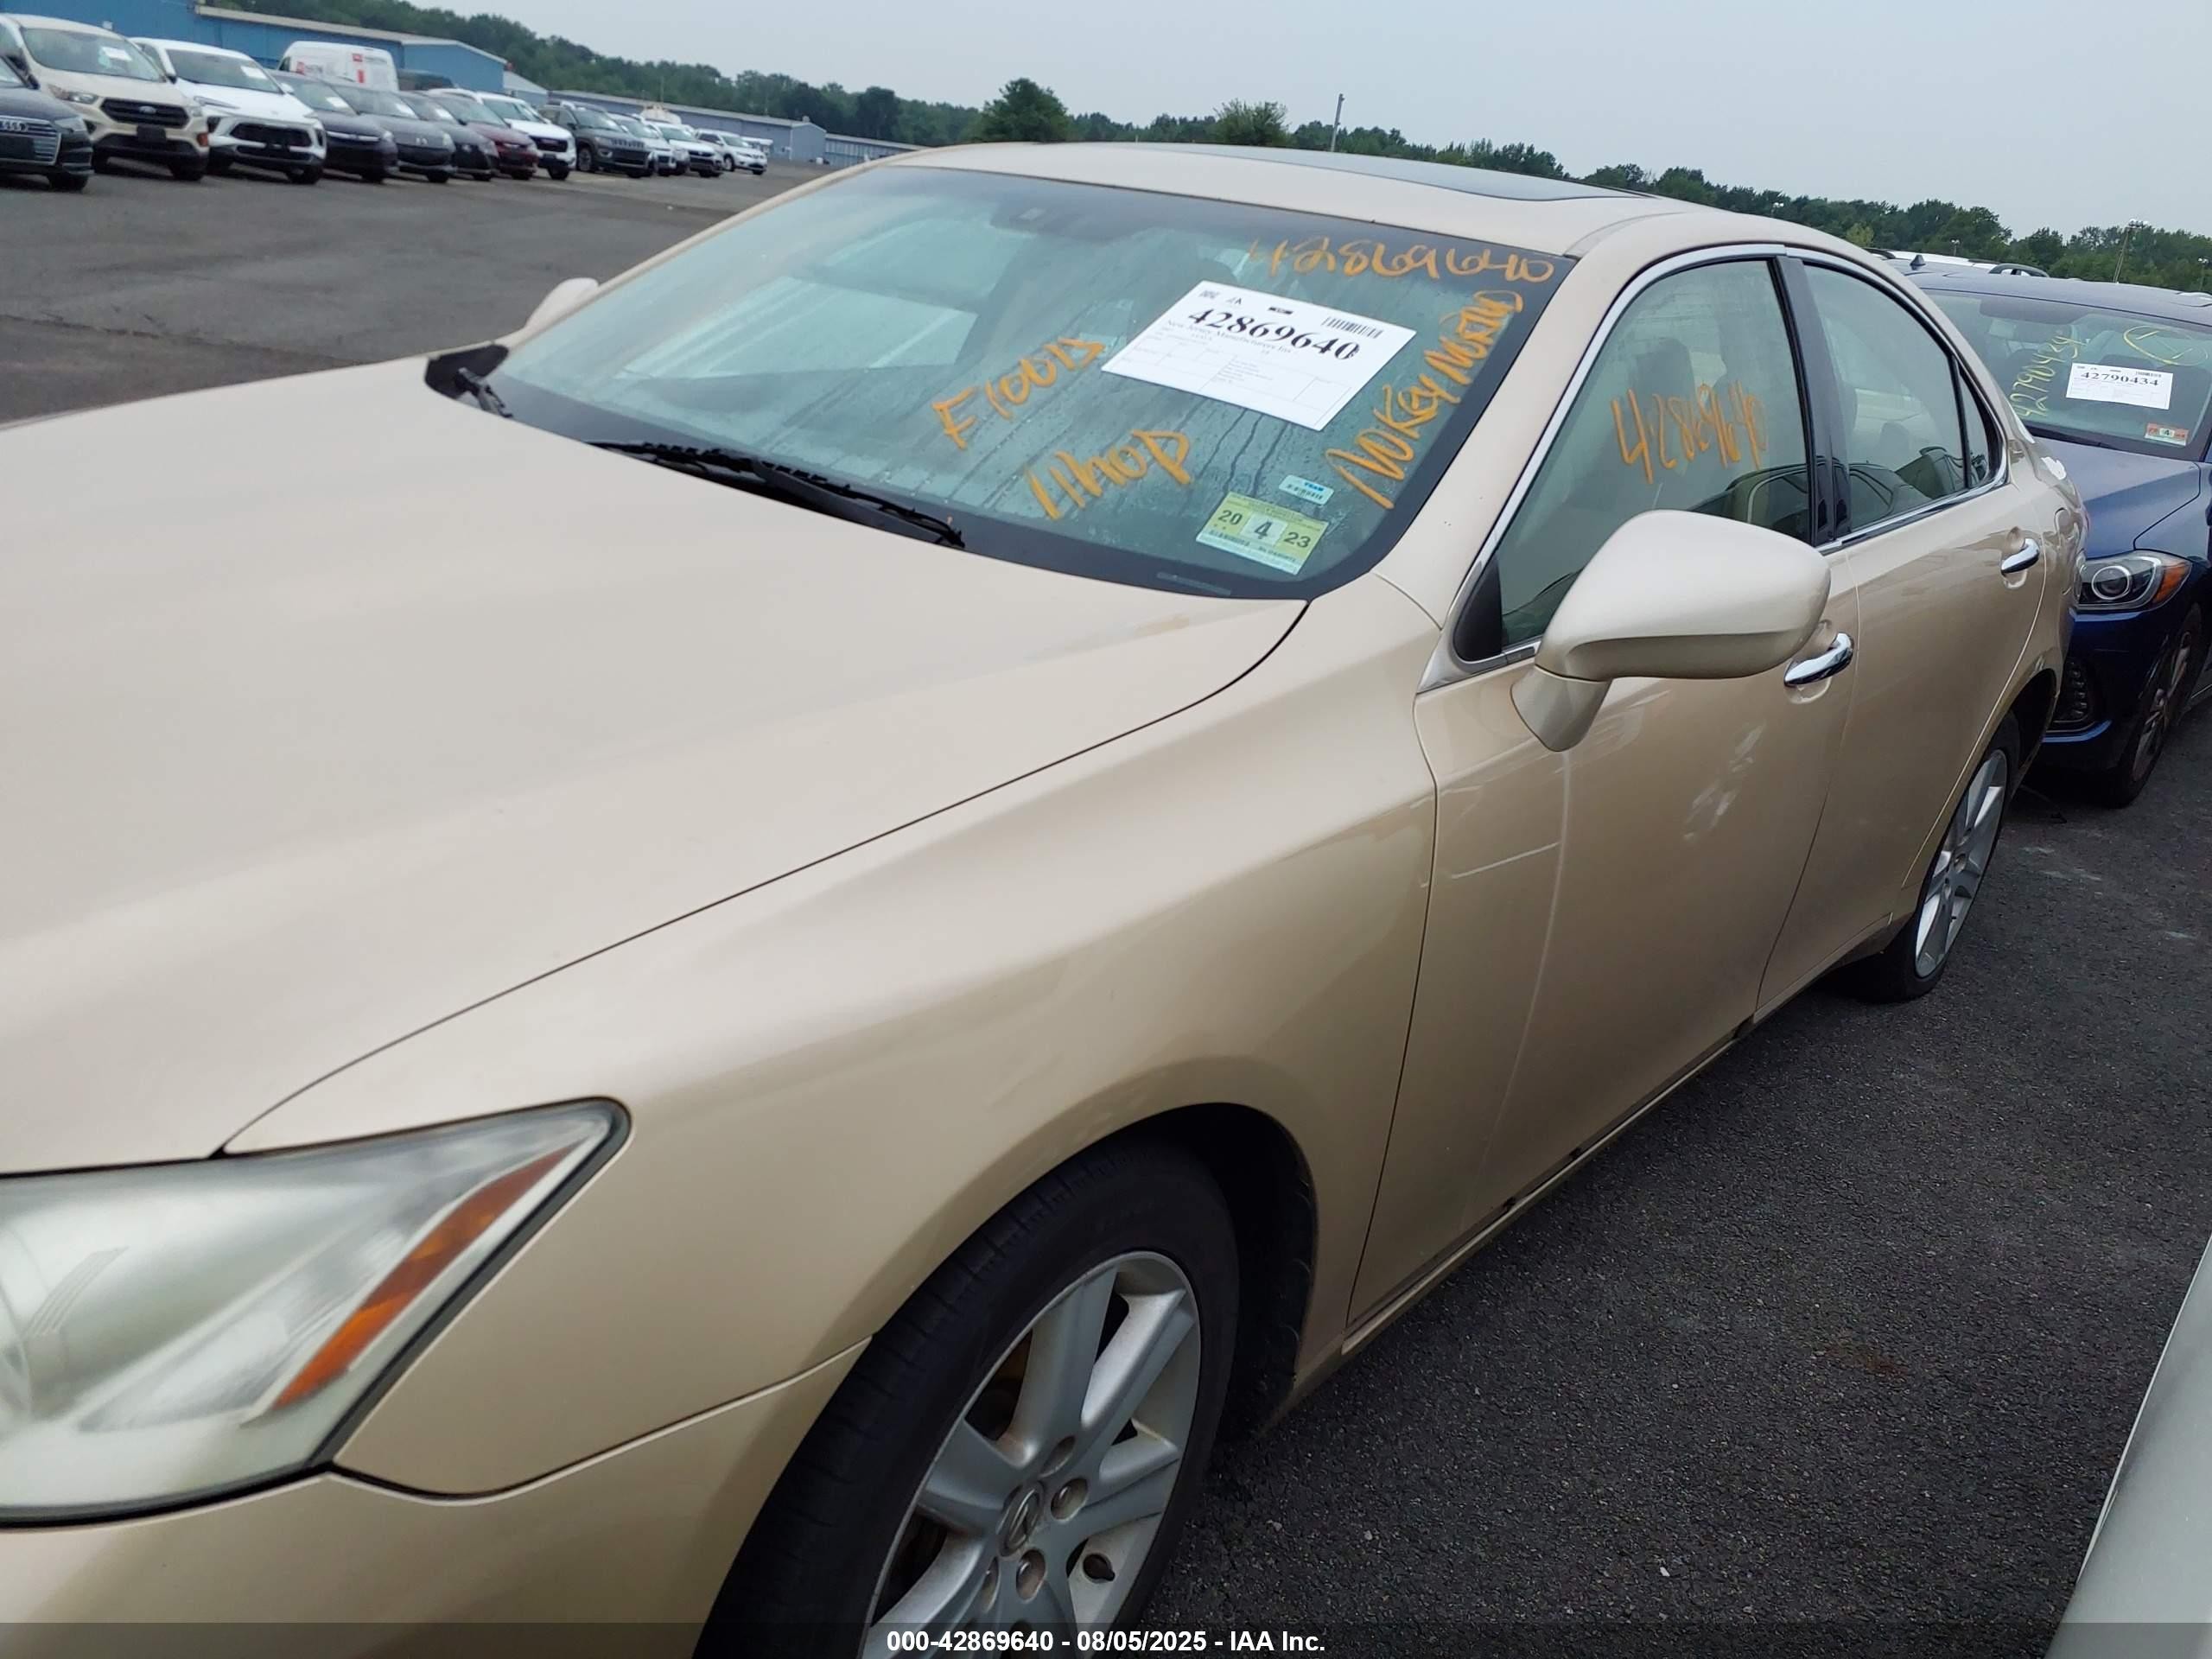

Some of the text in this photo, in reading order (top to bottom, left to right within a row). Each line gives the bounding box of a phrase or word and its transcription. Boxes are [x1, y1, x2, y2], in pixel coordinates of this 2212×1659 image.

[1188, 308, 1360, 360] 42869640
[2081, 372, 2158, 386] 42790434
[1218, 510, 1243, 525] 20
[1255, 521, 1274, 540] 4
[1284, 531, 1312, 548] 23
